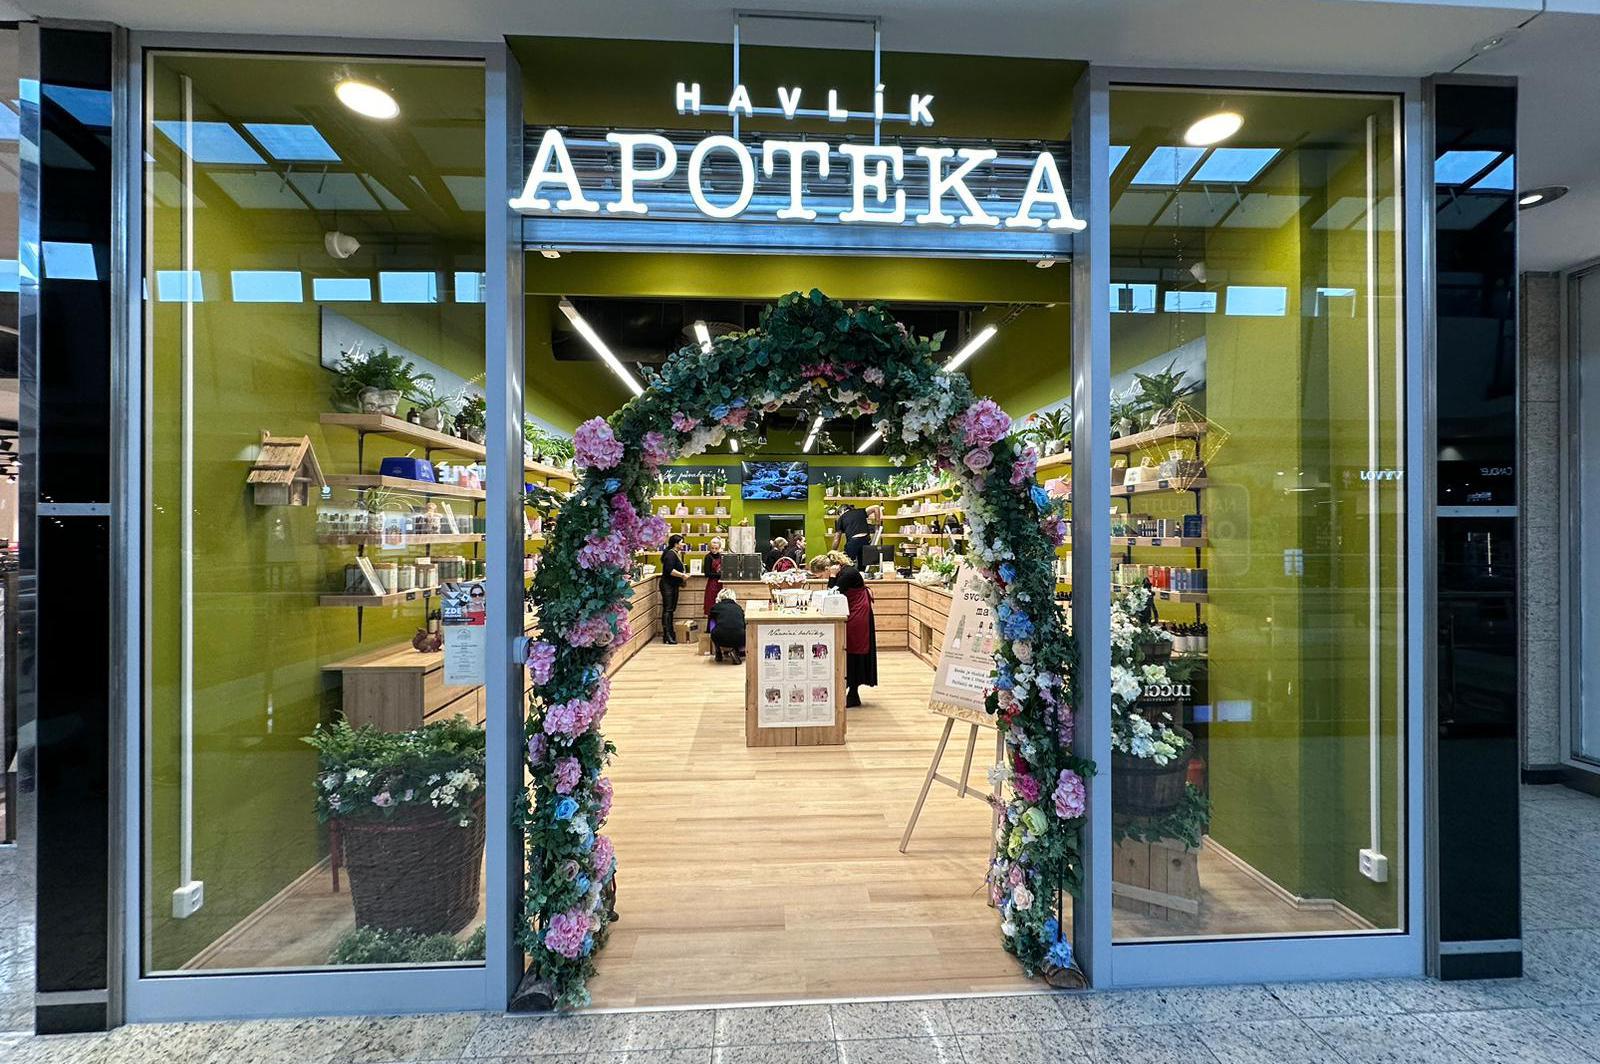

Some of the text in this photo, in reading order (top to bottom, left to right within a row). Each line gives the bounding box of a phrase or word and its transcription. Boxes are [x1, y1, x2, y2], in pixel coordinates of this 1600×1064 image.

[676, 81, 935, 126] HAVLÍK
[508, 128, 1088, 233] APOTEKA
[445, 607, 462, 615] ZDE
